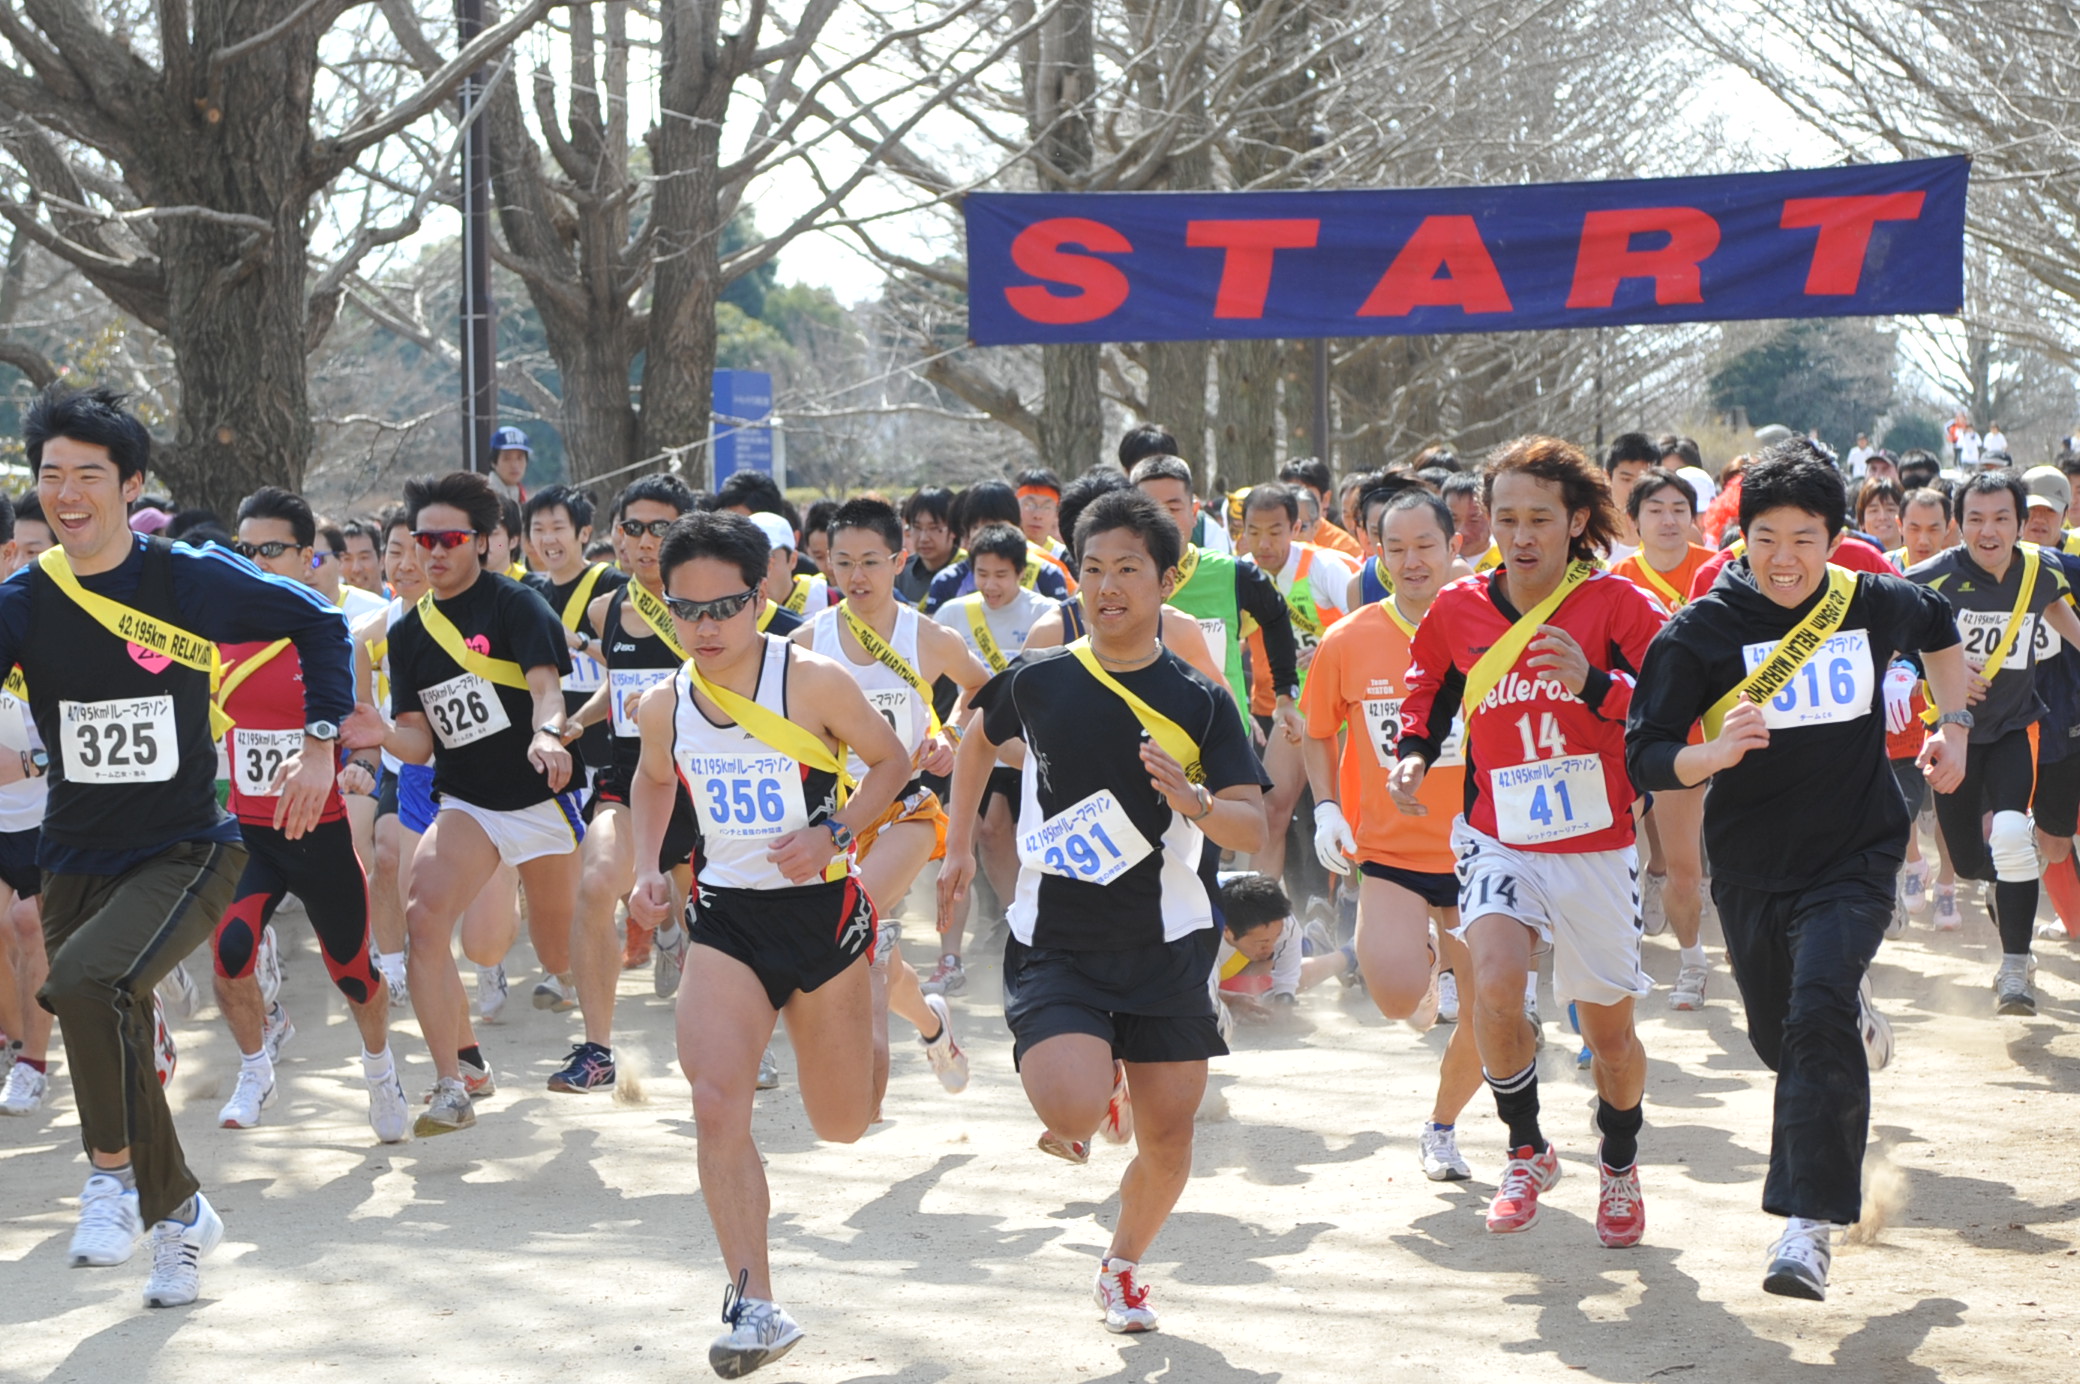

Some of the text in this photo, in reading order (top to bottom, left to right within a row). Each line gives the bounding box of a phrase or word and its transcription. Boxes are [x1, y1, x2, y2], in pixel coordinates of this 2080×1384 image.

[1004, 190, 1926, 325] START
[118, 613, 167, 650] 42.195km
[169, 633, 204, 664] RELAY
[860, 629, 920, 689] RELAY MARATHON
[1782, 627, 1821, 665] RELAY
[1736, 655, 1797, 705] MARATHO
[1771, 657, 1856, 712] 316
[433, 690, 490, 737] 326
[1514, 711, 1568, 763] 14
[76, 722, 158, 768] 325
[246, 748, 303, 783] 32
[706, 778, 785, 824] 356
[1529, 779, 1574, 826] 41
[1044, 822, 1123, 880] 391
[1476, 874, 1519, 912] 14
